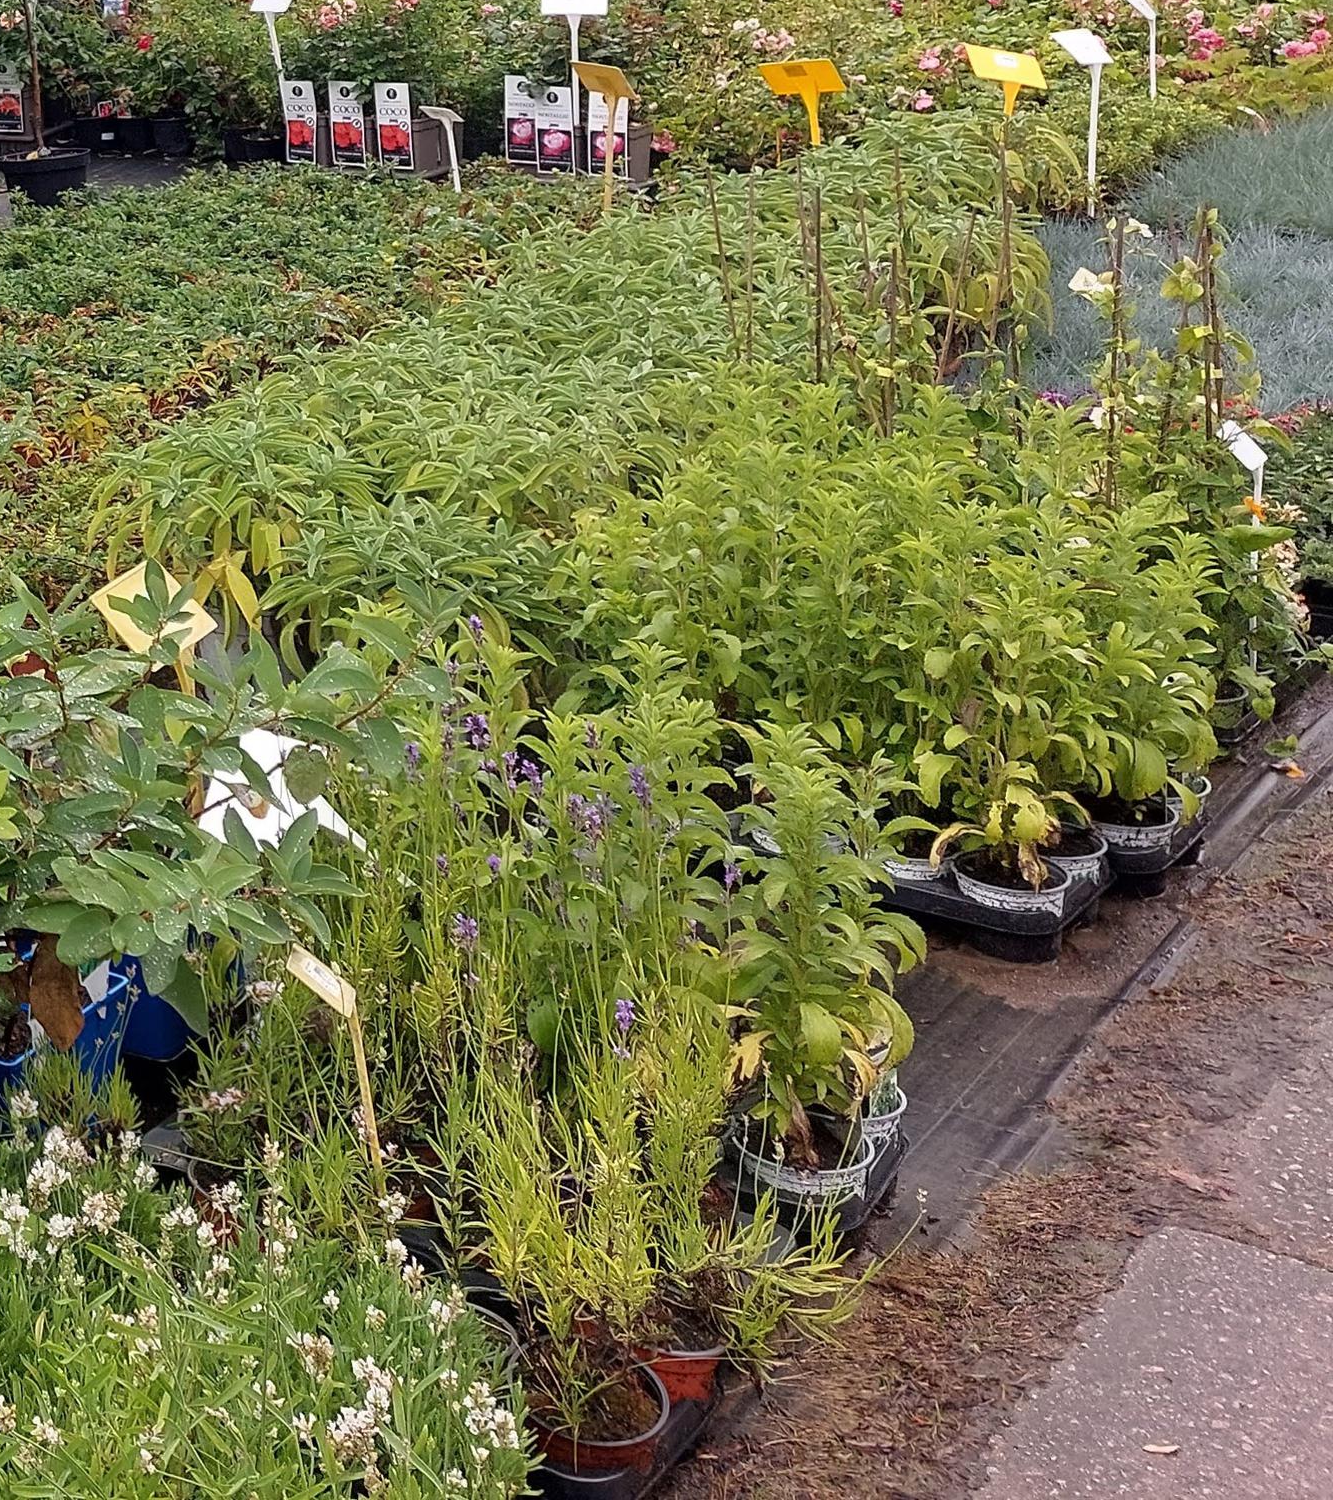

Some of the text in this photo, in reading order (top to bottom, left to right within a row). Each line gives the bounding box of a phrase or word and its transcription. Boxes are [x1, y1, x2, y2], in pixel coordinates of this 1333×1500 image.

[287, 104, 314, 113] COCO
[333, 105, 360, 113] COCO
[379, 108, 407, 116] COCO
